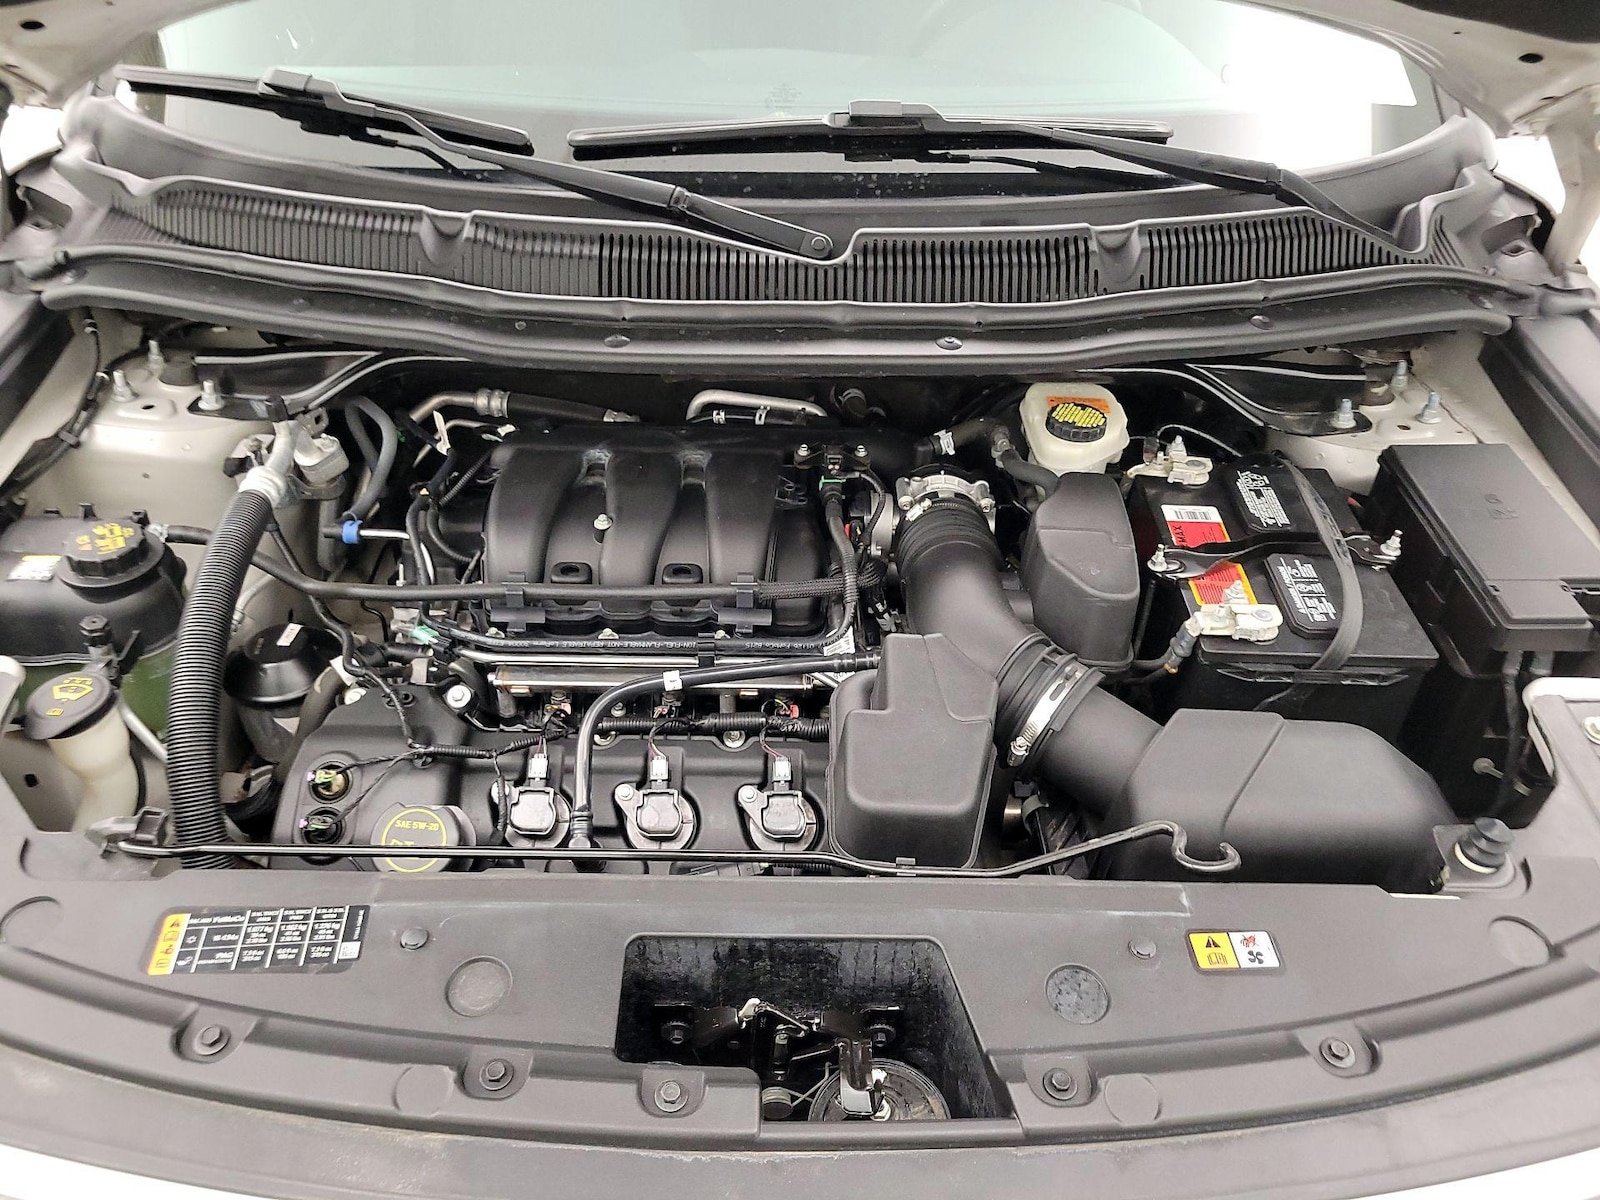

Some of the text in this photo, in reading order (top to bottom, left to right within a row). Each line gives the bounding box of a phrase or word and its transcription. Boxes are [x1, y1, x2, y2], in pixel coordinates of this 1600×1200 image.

[1173, 525, 1187, 543] MAX
[395, 820, 440, 831] SAE 5W-20
